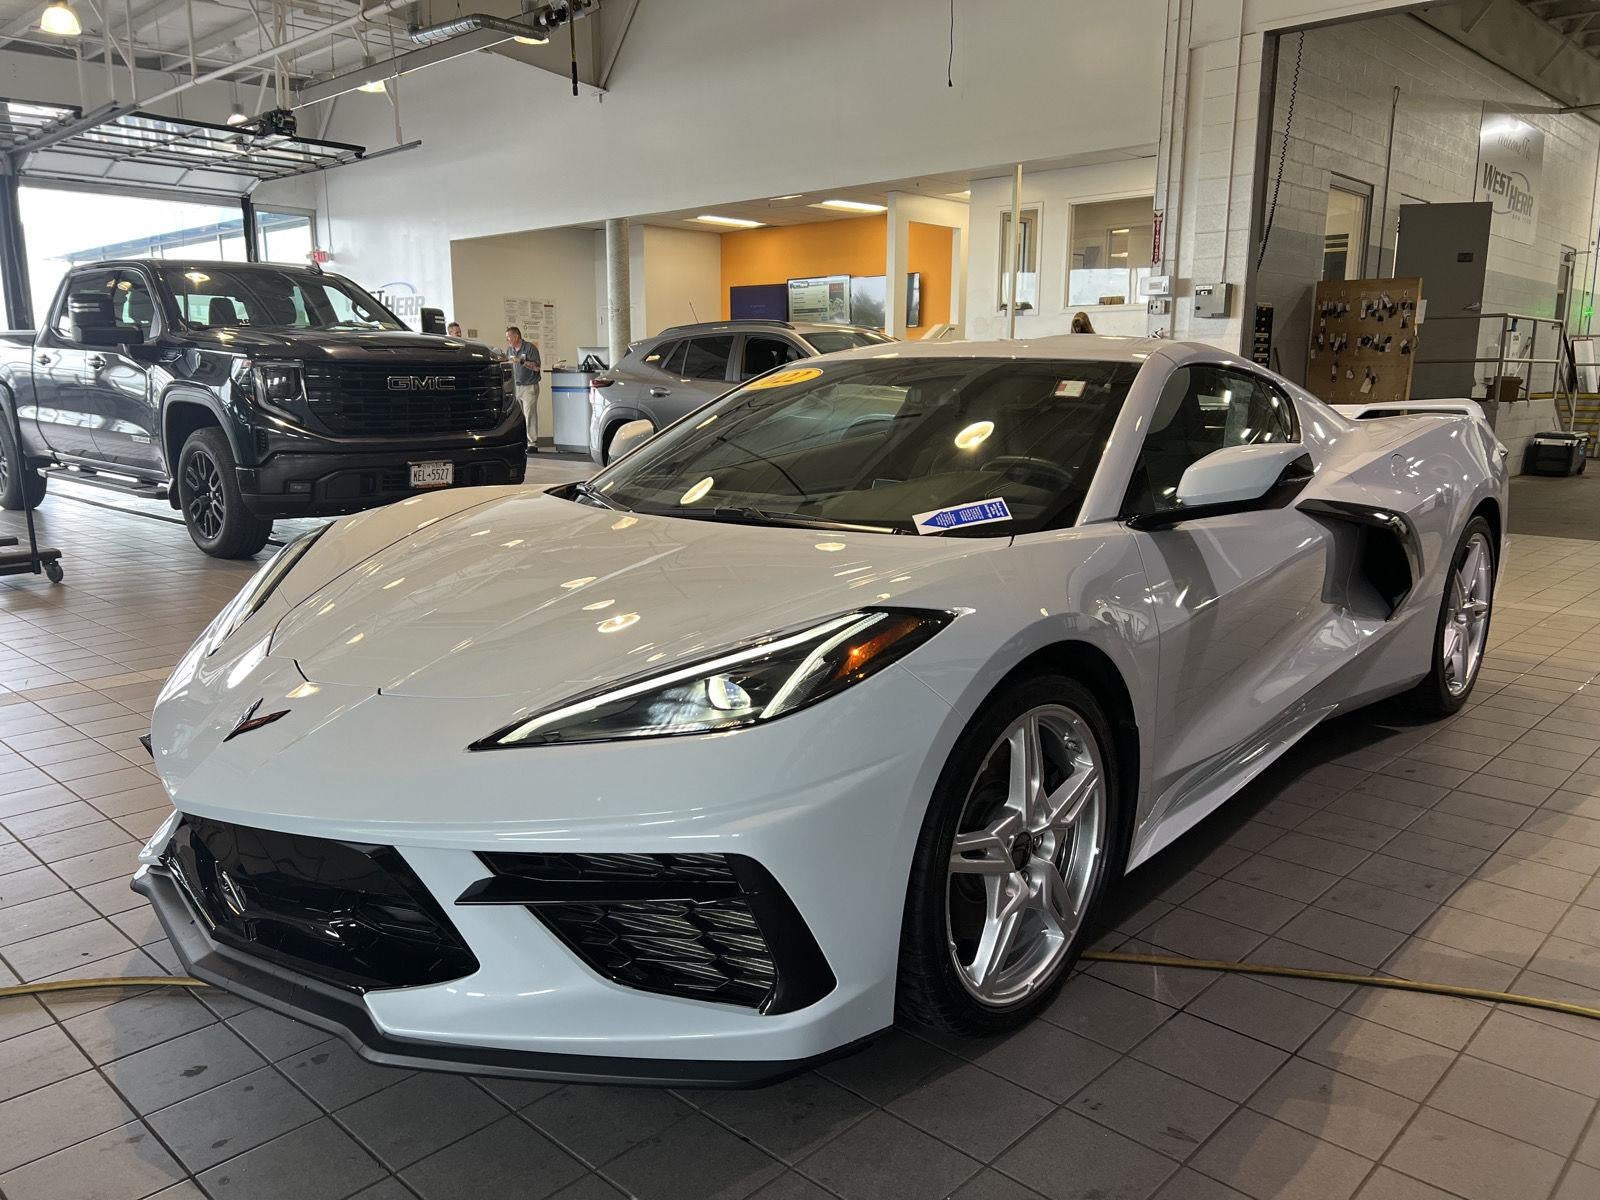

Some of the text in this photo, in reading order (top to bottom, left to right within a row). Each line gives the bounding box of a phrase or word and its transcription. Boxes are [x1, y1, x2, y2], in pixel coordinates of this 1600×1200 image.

[1483, 162, 1512, 197] WEST
[1507, 185, 1533, 216] HERR
[387, 375, 456, 391] GMC
